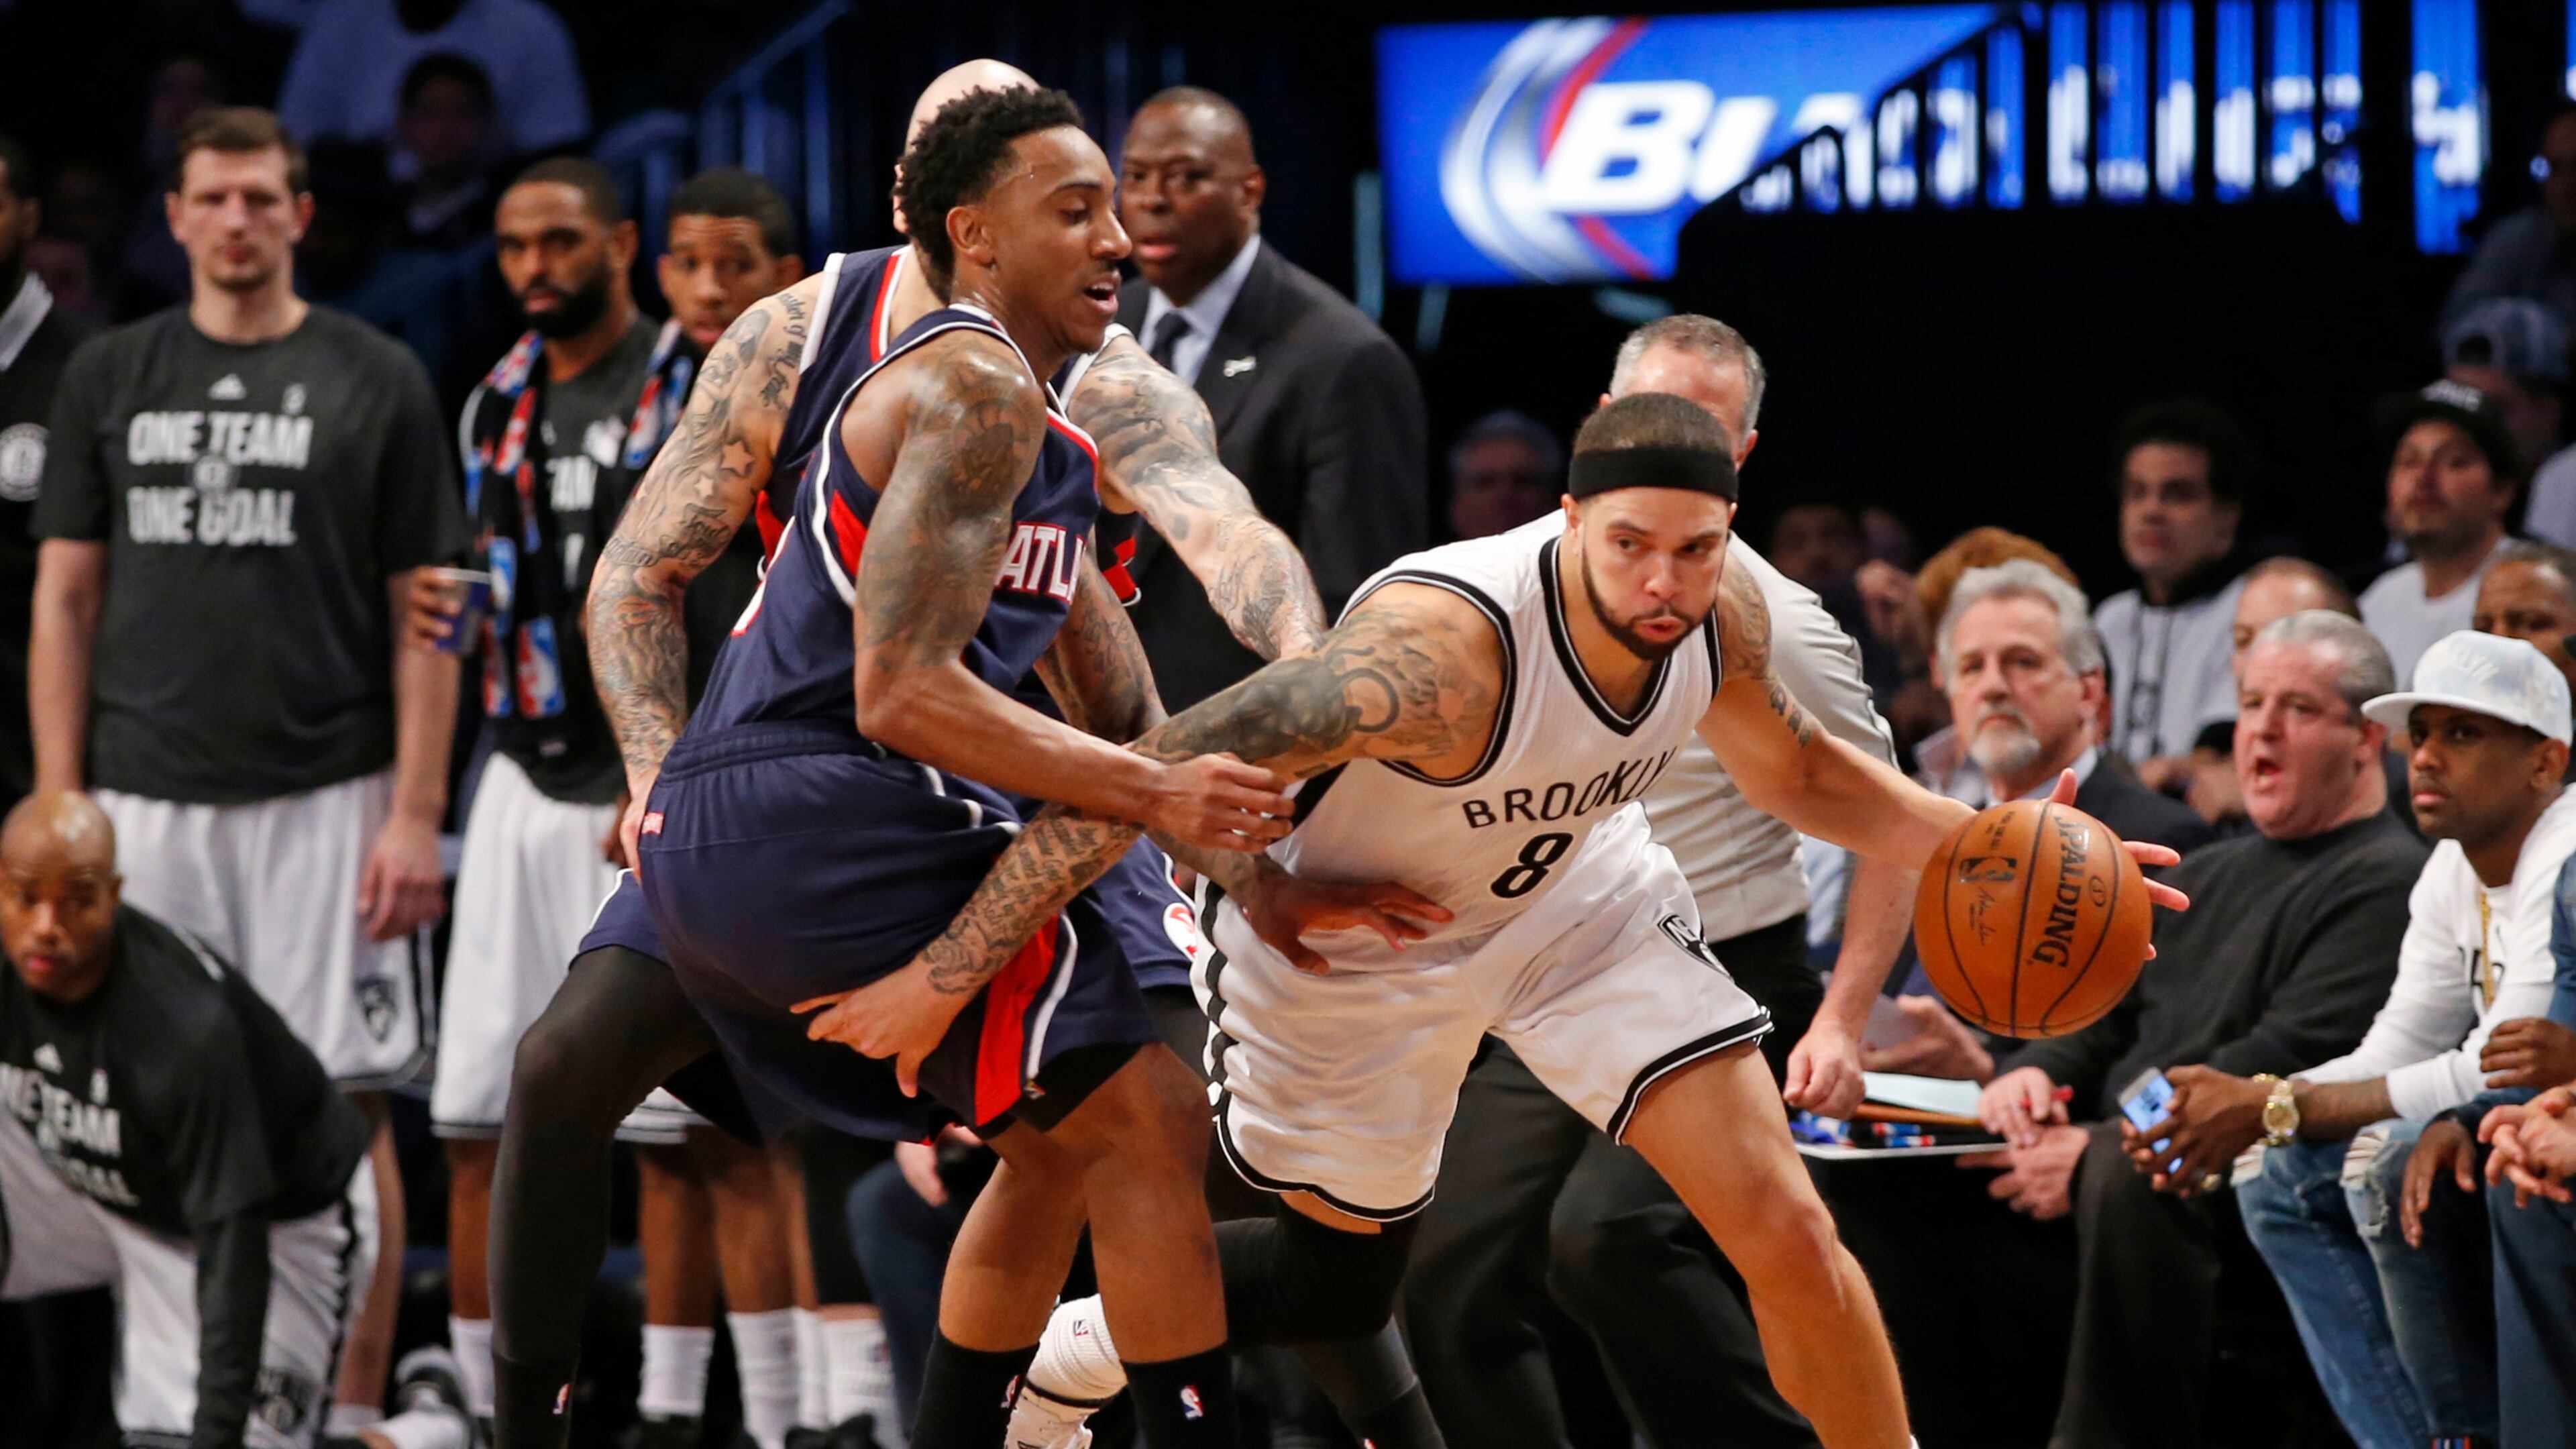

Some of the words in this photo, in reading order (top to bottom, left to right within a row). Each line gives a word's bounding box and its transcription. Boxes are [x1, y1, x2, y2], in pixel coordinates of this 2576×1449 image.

[127, 411, 204, 465] ONE
[207, 411, 313, 469] TEAM
[127, 486, 195, 544] ONE
[197, 487, 297, 547] GOAL
[1462, 746, 1677, 828] BROOKLY
[1491, 832, 1574, 898] 8
[2032, 815, 2091, 968] SPALDING
